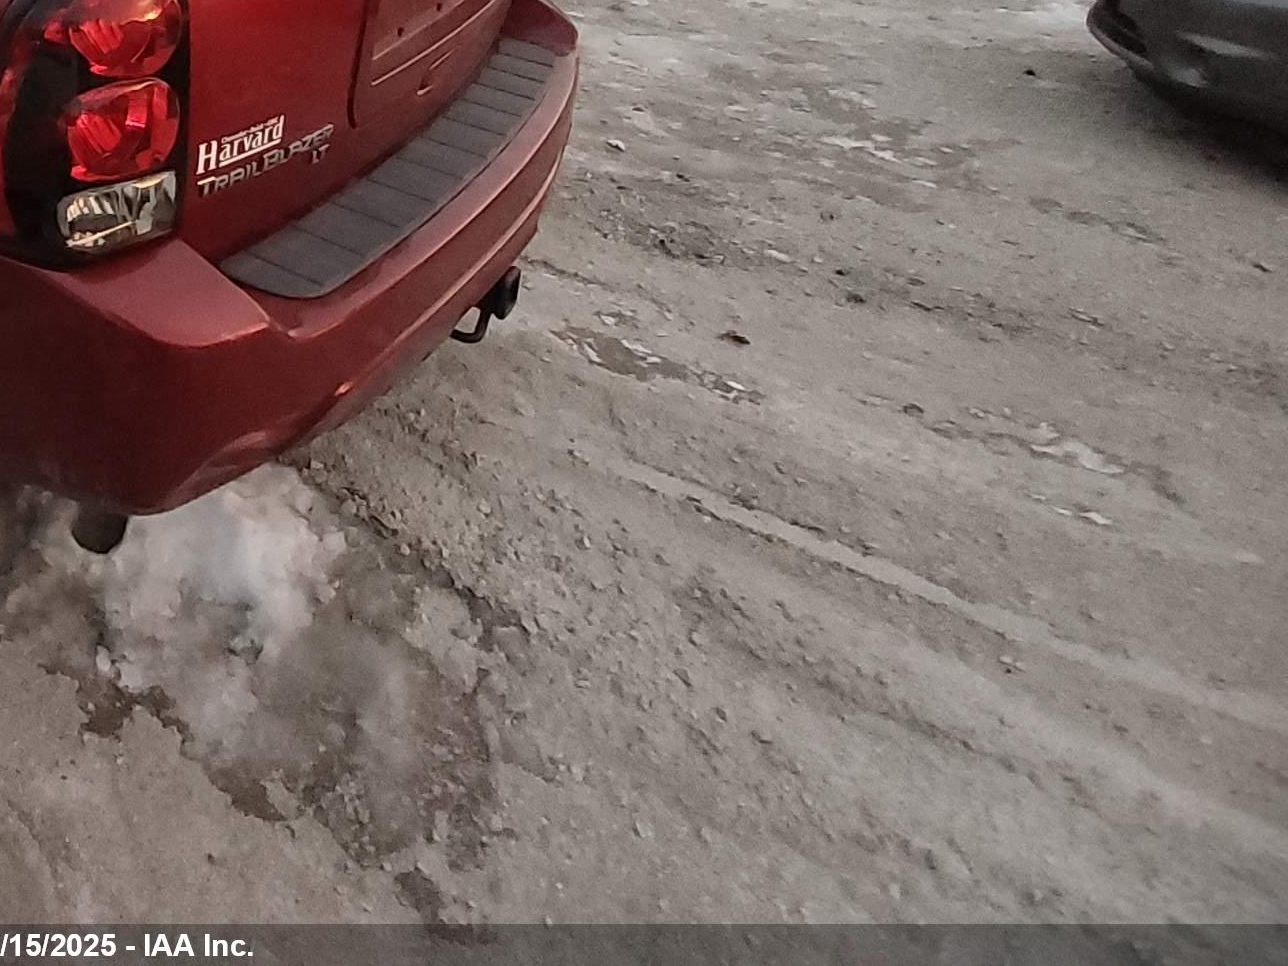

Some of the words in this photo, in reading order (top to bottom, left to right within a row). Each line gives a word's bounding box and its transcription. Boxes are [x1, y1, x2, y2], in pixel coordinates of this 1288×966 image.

[196, 115, 285, 175] Harvard
[197, 124, 334, 197] TRAILBLAZER
[311, 144, 330, 164] LT
